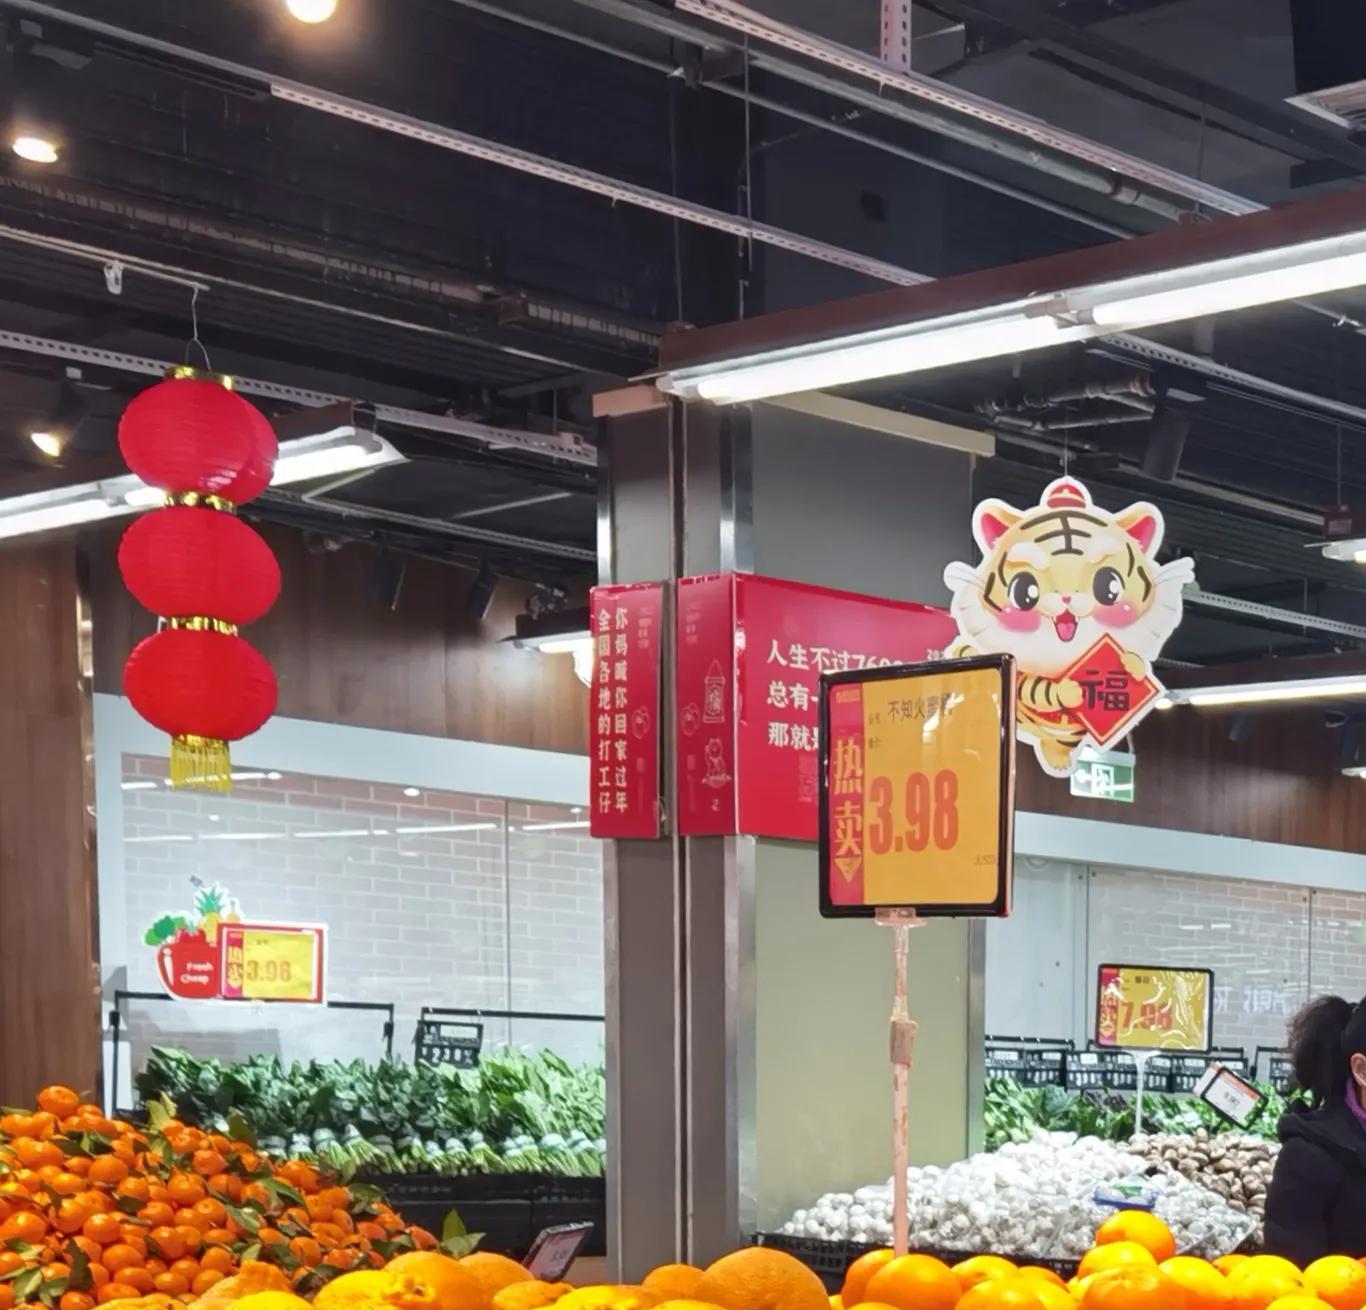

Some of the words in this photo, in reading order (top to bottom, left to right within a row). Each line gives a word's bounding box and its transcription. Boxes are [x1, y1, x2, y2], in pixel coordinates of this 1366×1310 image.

[598, 608, 611, 814] 全国各地的打工仔
[615, 607, 628, 814] 你妈喊你回家过年
[1081, 669, 1130, 712] 福
[834, 738, 863, 857] 热卖
[869, 768, 960, 856] 3.98
